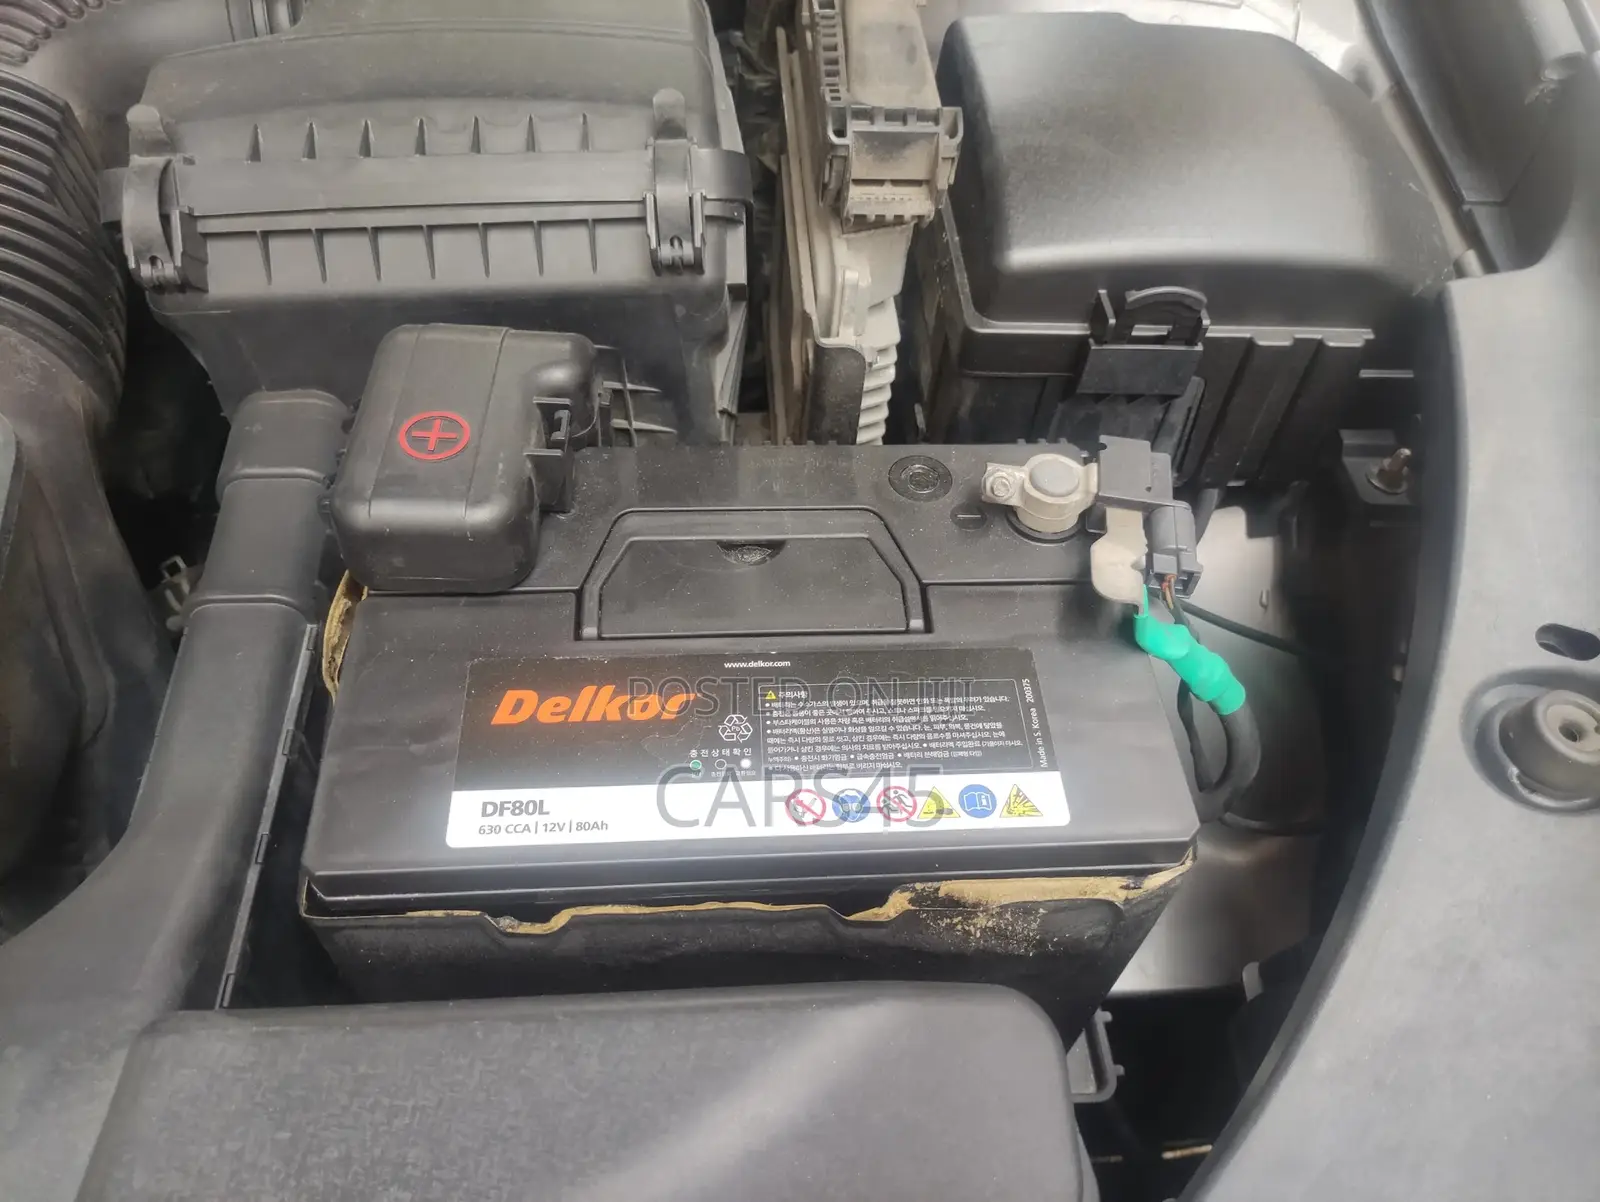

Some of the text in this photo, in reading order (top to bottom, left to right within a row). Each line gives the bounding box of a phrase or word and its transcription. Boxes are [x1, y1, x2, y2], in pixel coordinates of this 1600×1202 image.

[724, 660, 791, 668] www.delkor.com
[490, 684, 696, 726] Delkor
[1030, 708, 1040, 728] Korea
[1036, 746, 1048, 768] Made
[481, 800, 550, 818] DF80L
[478, 824, 501, 834] 630
[505, 824, 532, 834] CCA
[542, 822, 566, 832] 12V
[576, 820, 608, 832] 80Ah
